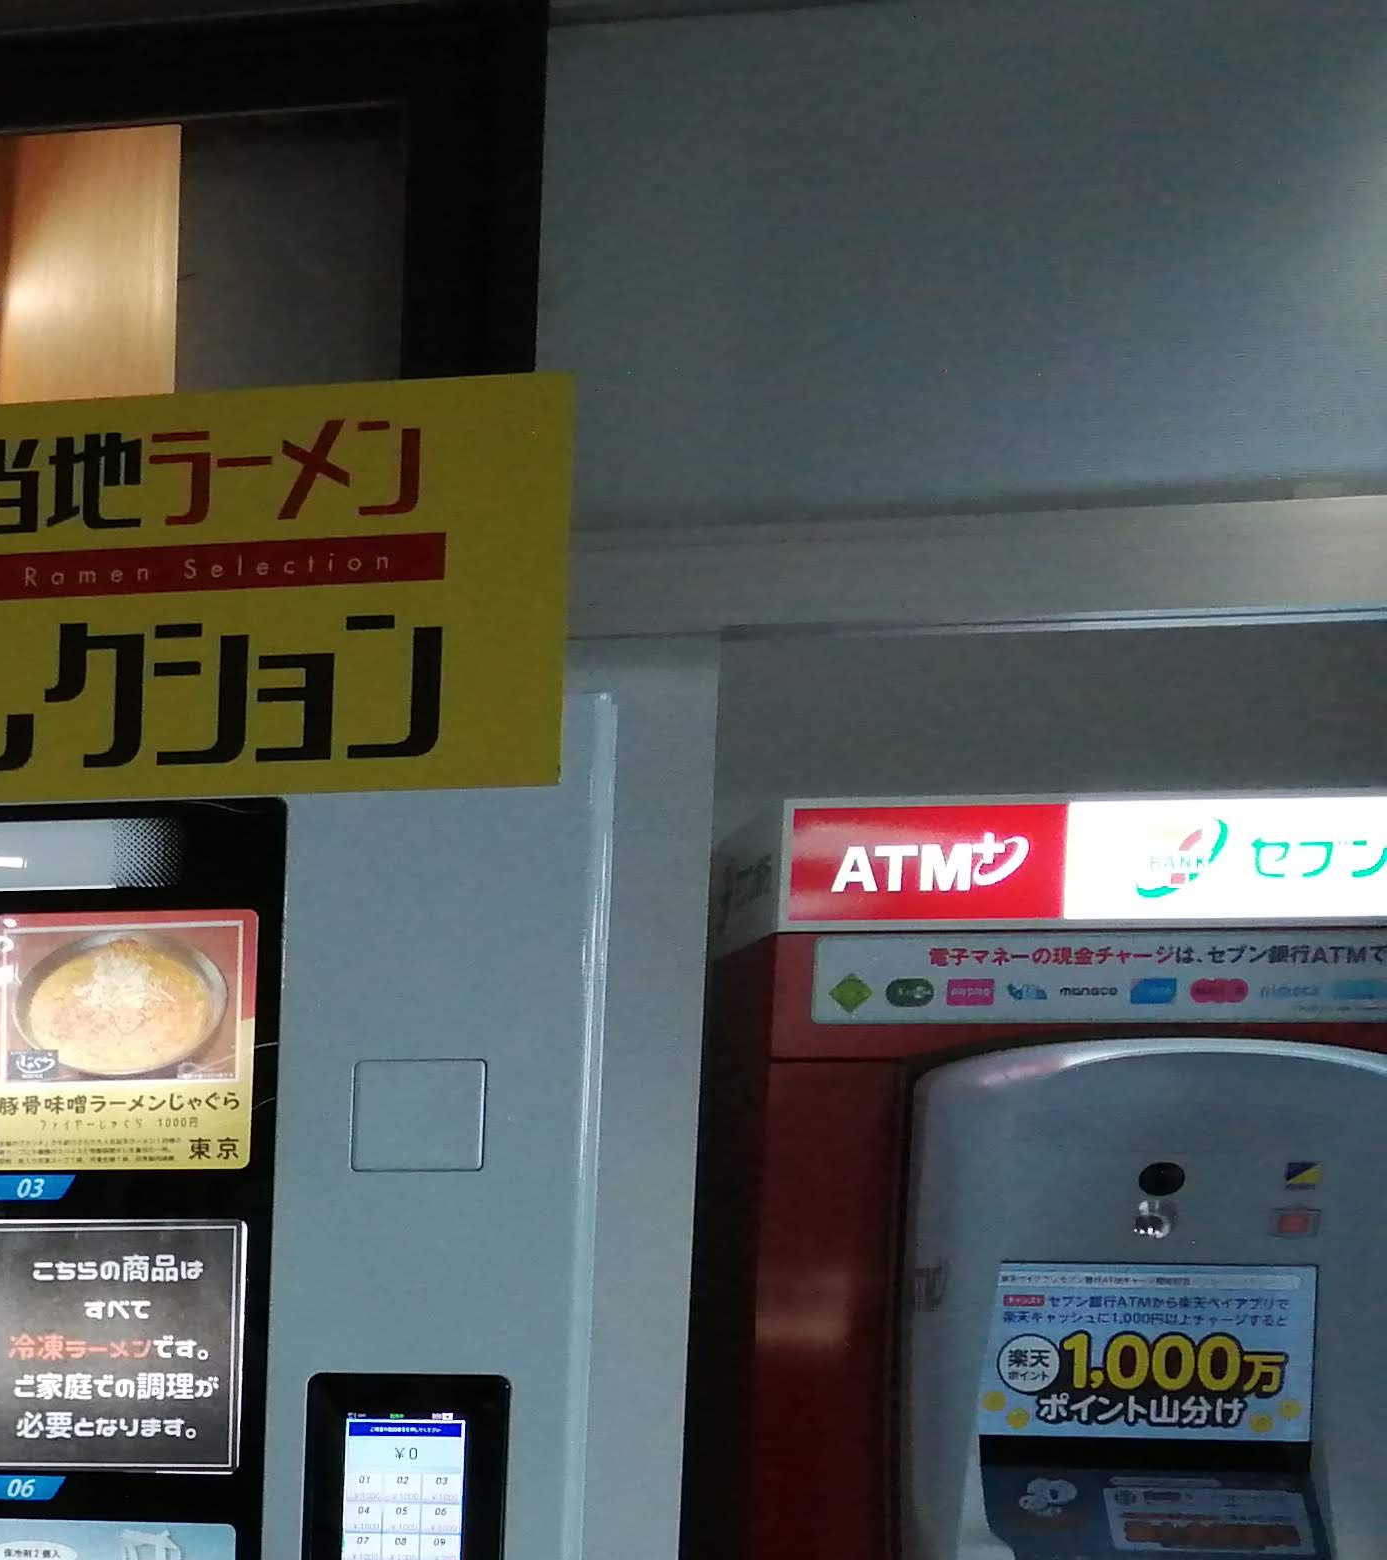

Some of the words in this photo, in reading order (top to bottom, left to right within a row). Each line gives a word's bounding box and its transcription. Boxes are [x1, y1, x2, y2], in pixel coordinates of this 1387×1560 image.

[24, 562, 152, 590] Ramen
[184, 551, 395, 580] Selection
[830, 843, 973, 893] ATM
[157, 1117, 199, 1130] 1000円
[188, 1136, 240, 1161] 東京
[15, 1178, 45, 1199] 03
[32, 1253, 204, 1283] こちらの商品は
[84, 1300, 152, 1320] すべて
[7, 1333, 210, 1361] 冷凍ラーメンです。
[1007, 1348, 1051, 1369] 楽天
[1062, 1332, 1287, 1395] 1,000万
[13, 1372, 220, 1401] ご家庭での調理が
[1008, 1371, 1050, 1383] ポイント
[1037, 1394, 1246, 1427] ポイント山分け
[15, 1411, 198, 1440] 必要となります。
[6, 1478, 36, 1498] 06
[396, 1476, 410, 1485] 02
[435, 1476, 449, 1486] 03
[357, 1505, 370, 1516] 04
[395, 1506, 409, 1516] 05
[434, 1506, 447, 1517] 06
[356, 1536, 370, 1546] 07
[394, 1537, 408, 1547] 08
[433, 1537, 446, 1547] 09
